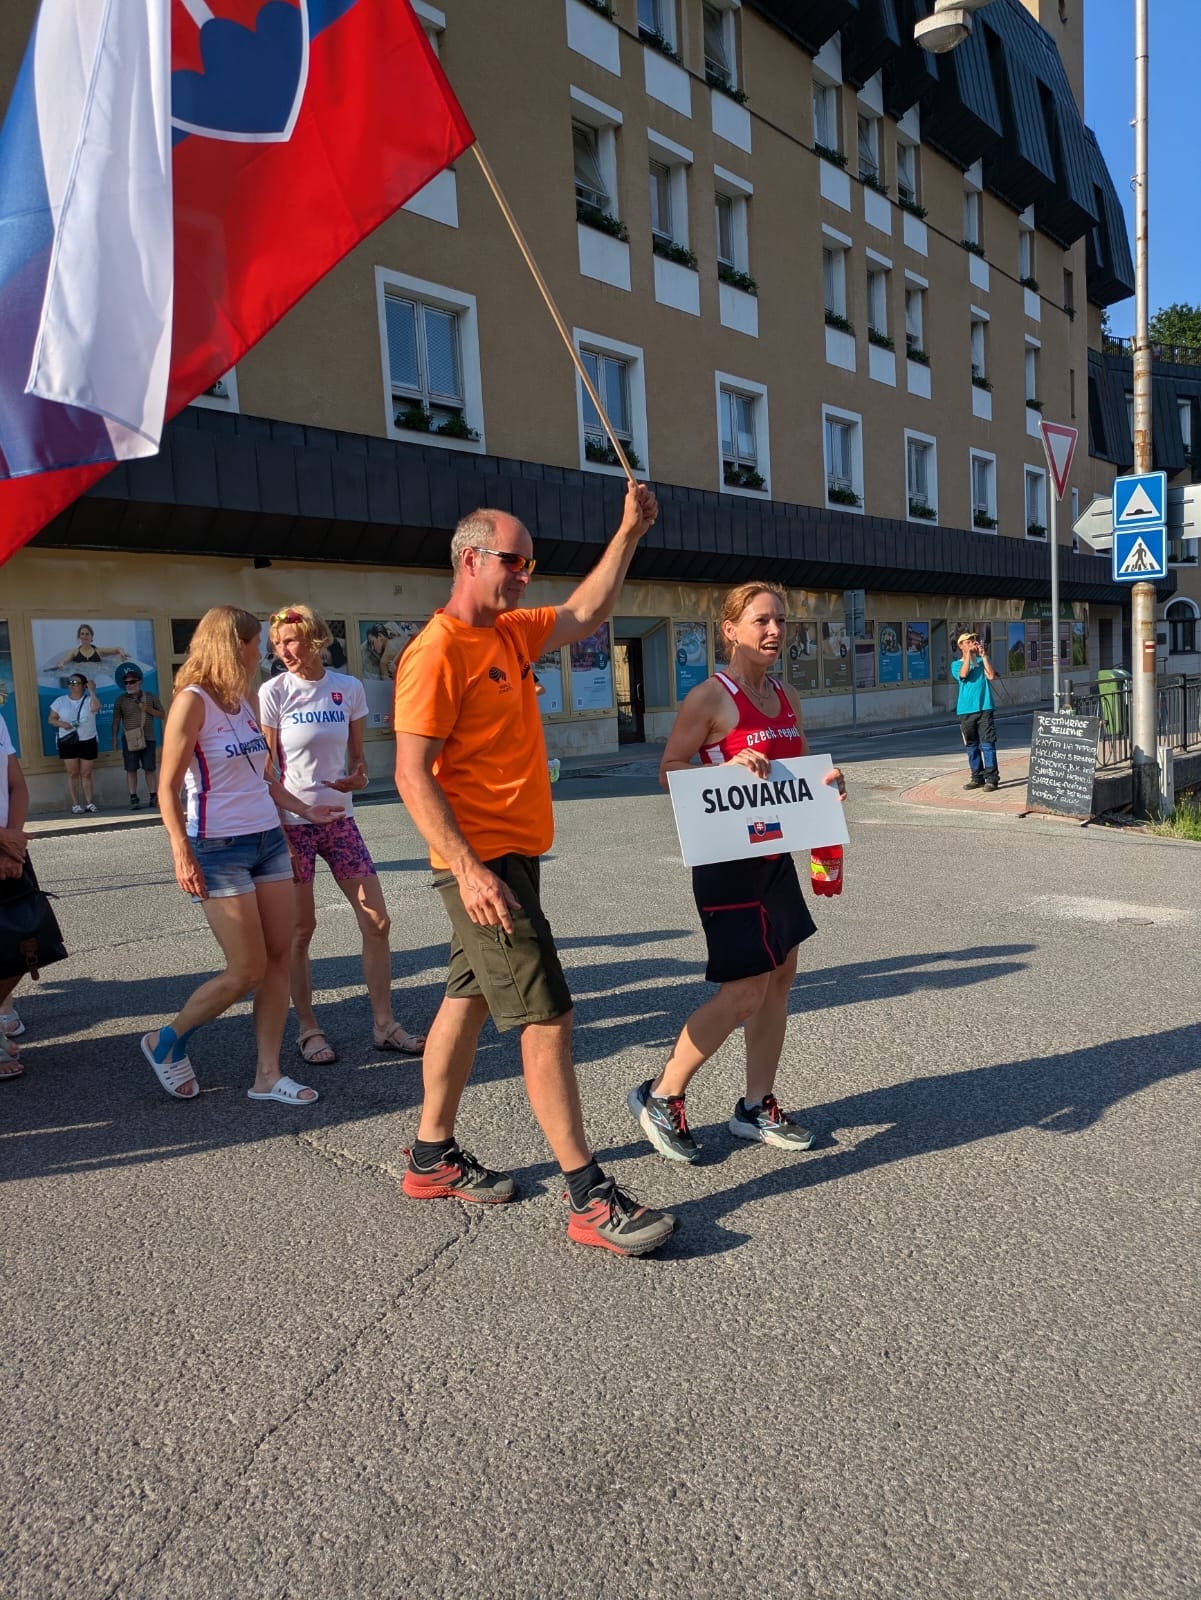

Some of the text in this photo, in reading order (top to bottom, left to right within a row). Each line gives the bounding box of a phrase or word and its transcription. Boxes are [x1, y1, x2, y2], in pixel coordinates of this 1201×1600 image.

[292, 710, 345, 724] SLOVAKIA
[1037, 715, 1089, 729] RESTAURACE
[702, 778, 814, 814] SLOVAKIA
